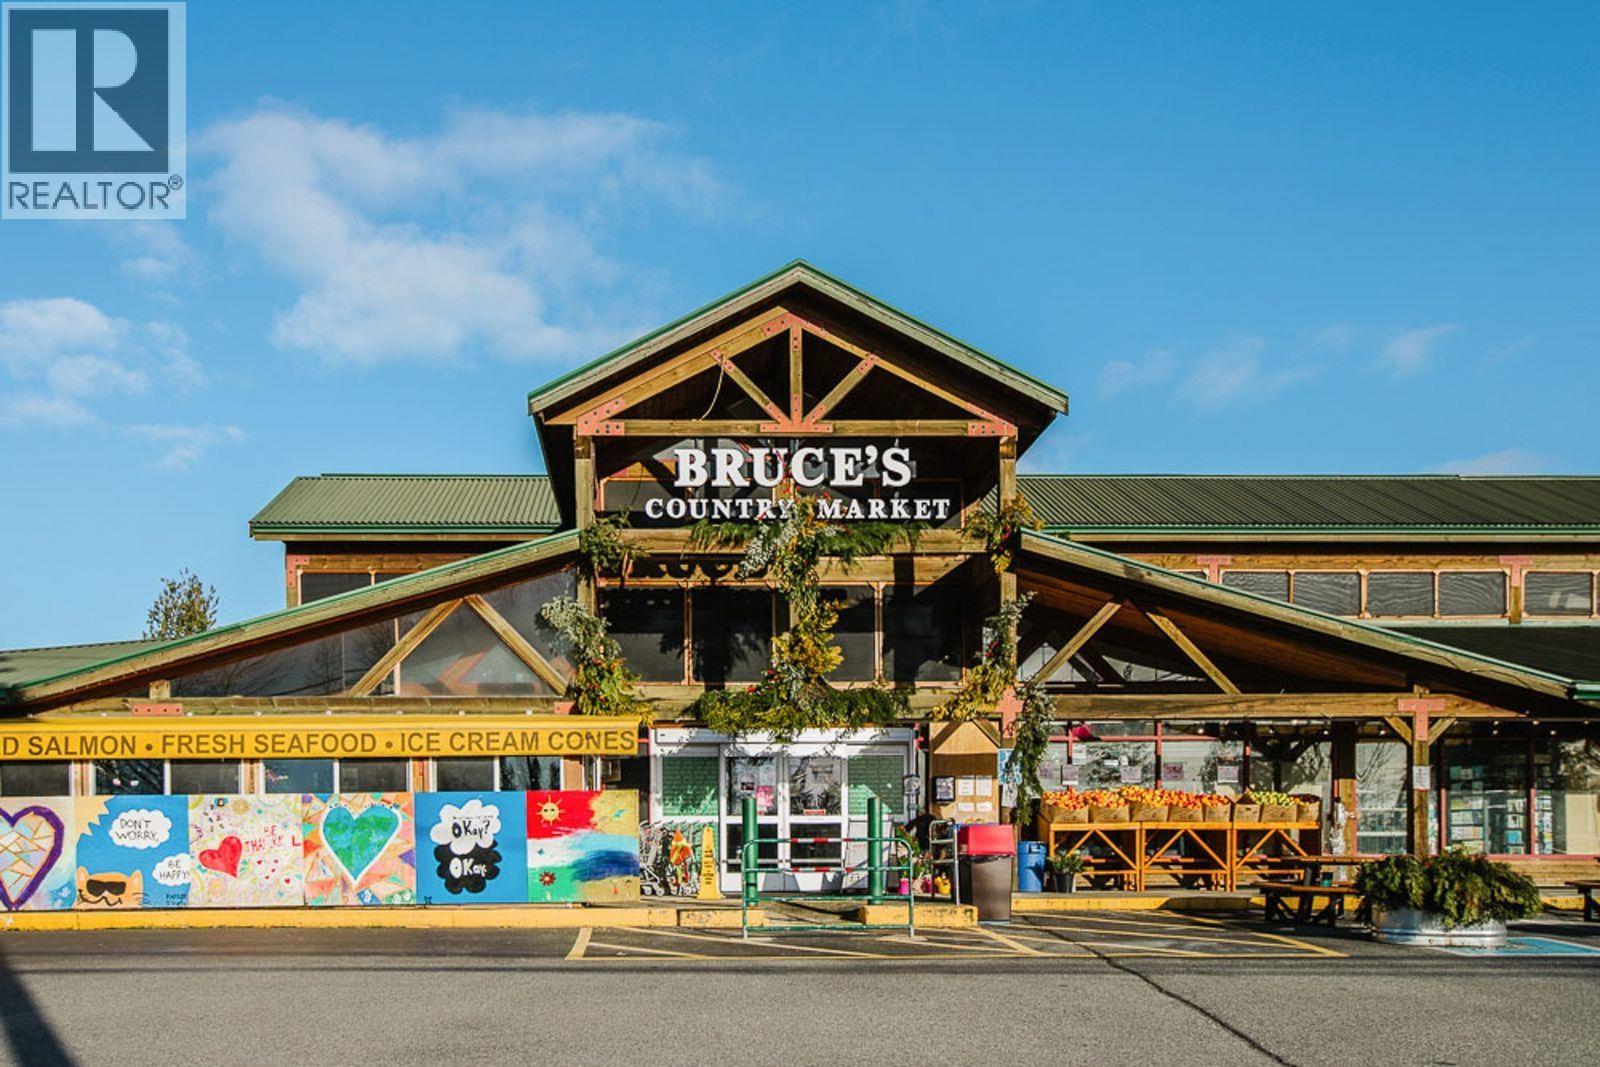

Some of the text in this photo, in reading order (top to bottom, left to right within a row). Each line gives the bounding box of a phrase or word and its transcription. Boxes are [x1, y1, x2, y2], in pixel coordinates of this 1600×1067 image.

[674, 445, 913, 487] BRUCE'S
[816, 498, 950, 519] MARKET
[28, 735, 136, 756] SALMON
[162, 734, 245, 755] FRESH
[254, 732, 377, 754] SEAFOOD
[401, 733, 441, 752] ICE
[449, 732, 540, 751] CREAM
[548, 730, 635, 750] CONES
